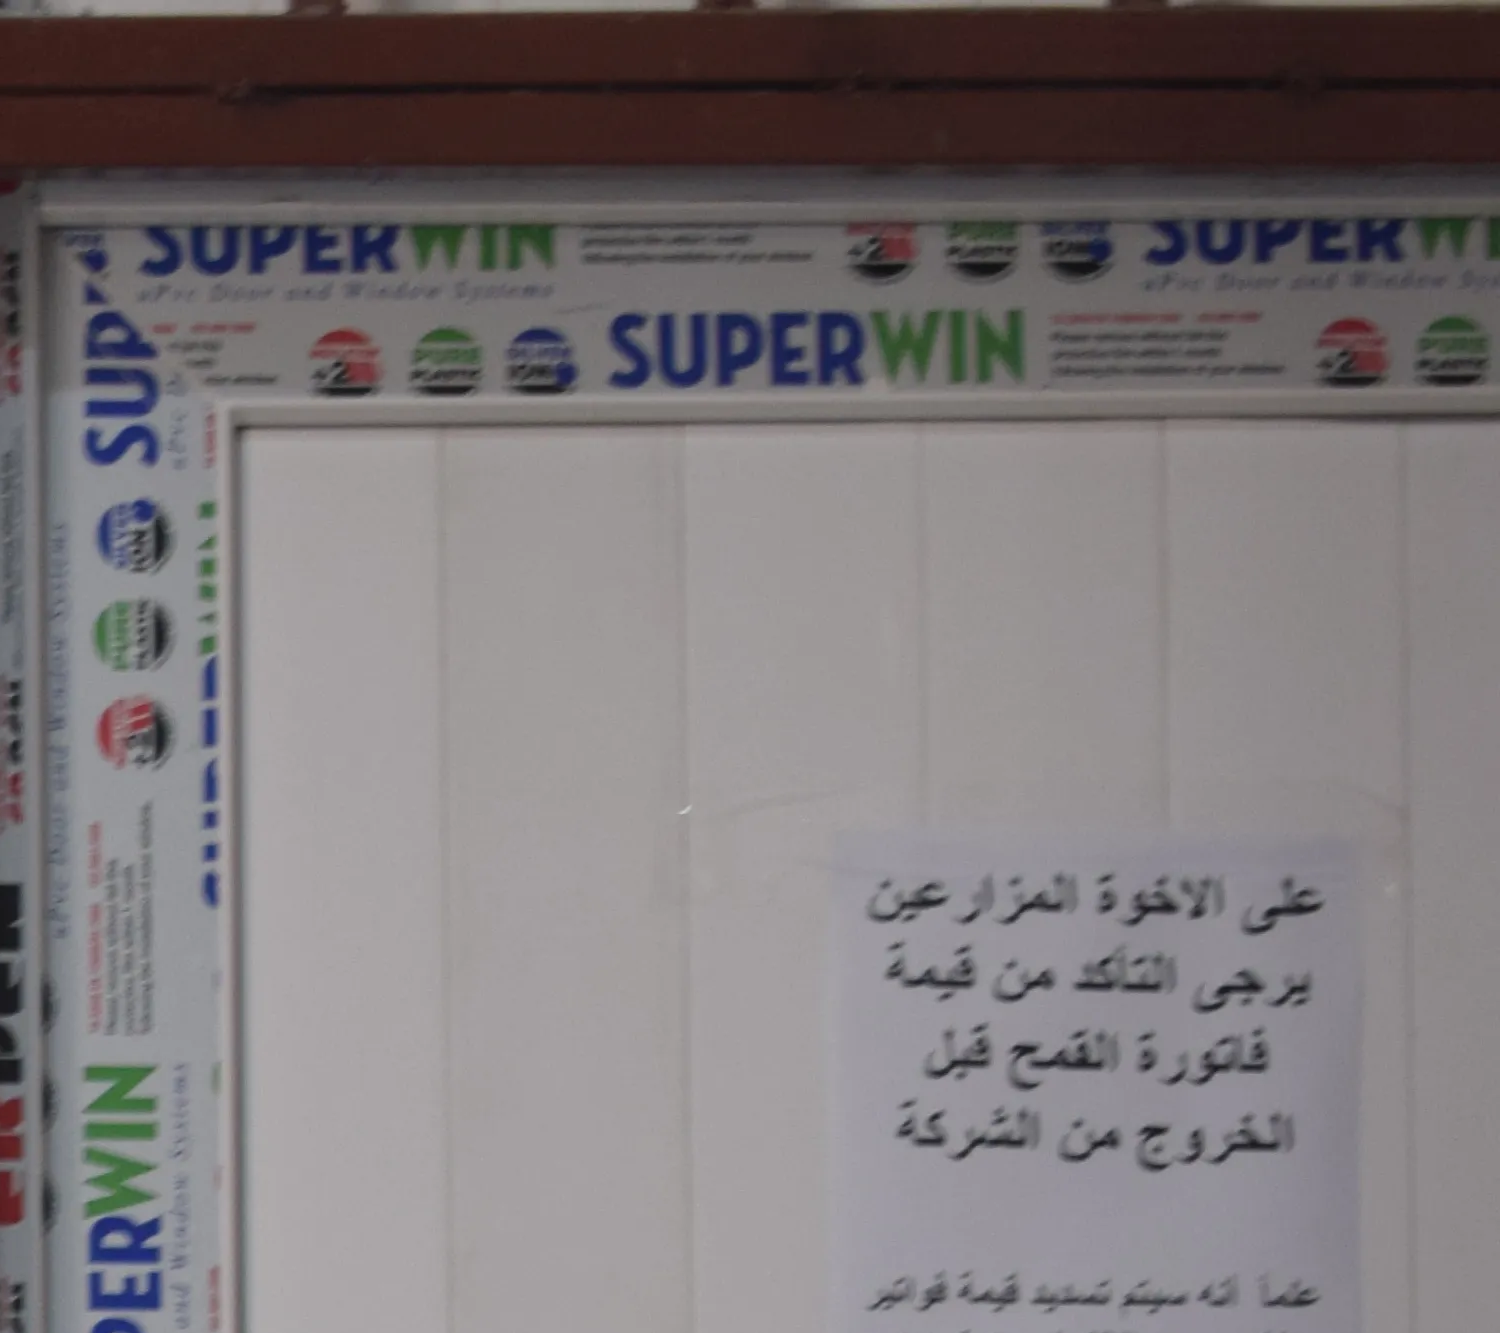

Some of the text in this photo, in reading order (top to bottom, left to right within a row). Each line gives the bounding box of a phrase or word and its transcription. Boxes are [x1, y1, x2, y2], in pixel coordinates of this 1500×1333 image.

[607, 309, 1027, 389] SUPERWIN
[863, 870, 1080, 924] المزارعين
[883, 940, 979, 1001] قيمة
[990, 957, 1058, 1003] من
[1191, 962, 1315, 1014] يرجى
[922, 1021, 1272, 1091] فاتورة القمح قبل
[894, 1096, 1297, 1172] الخروج من الشركة
[956, 1268, 1023, 1314] قيمة
